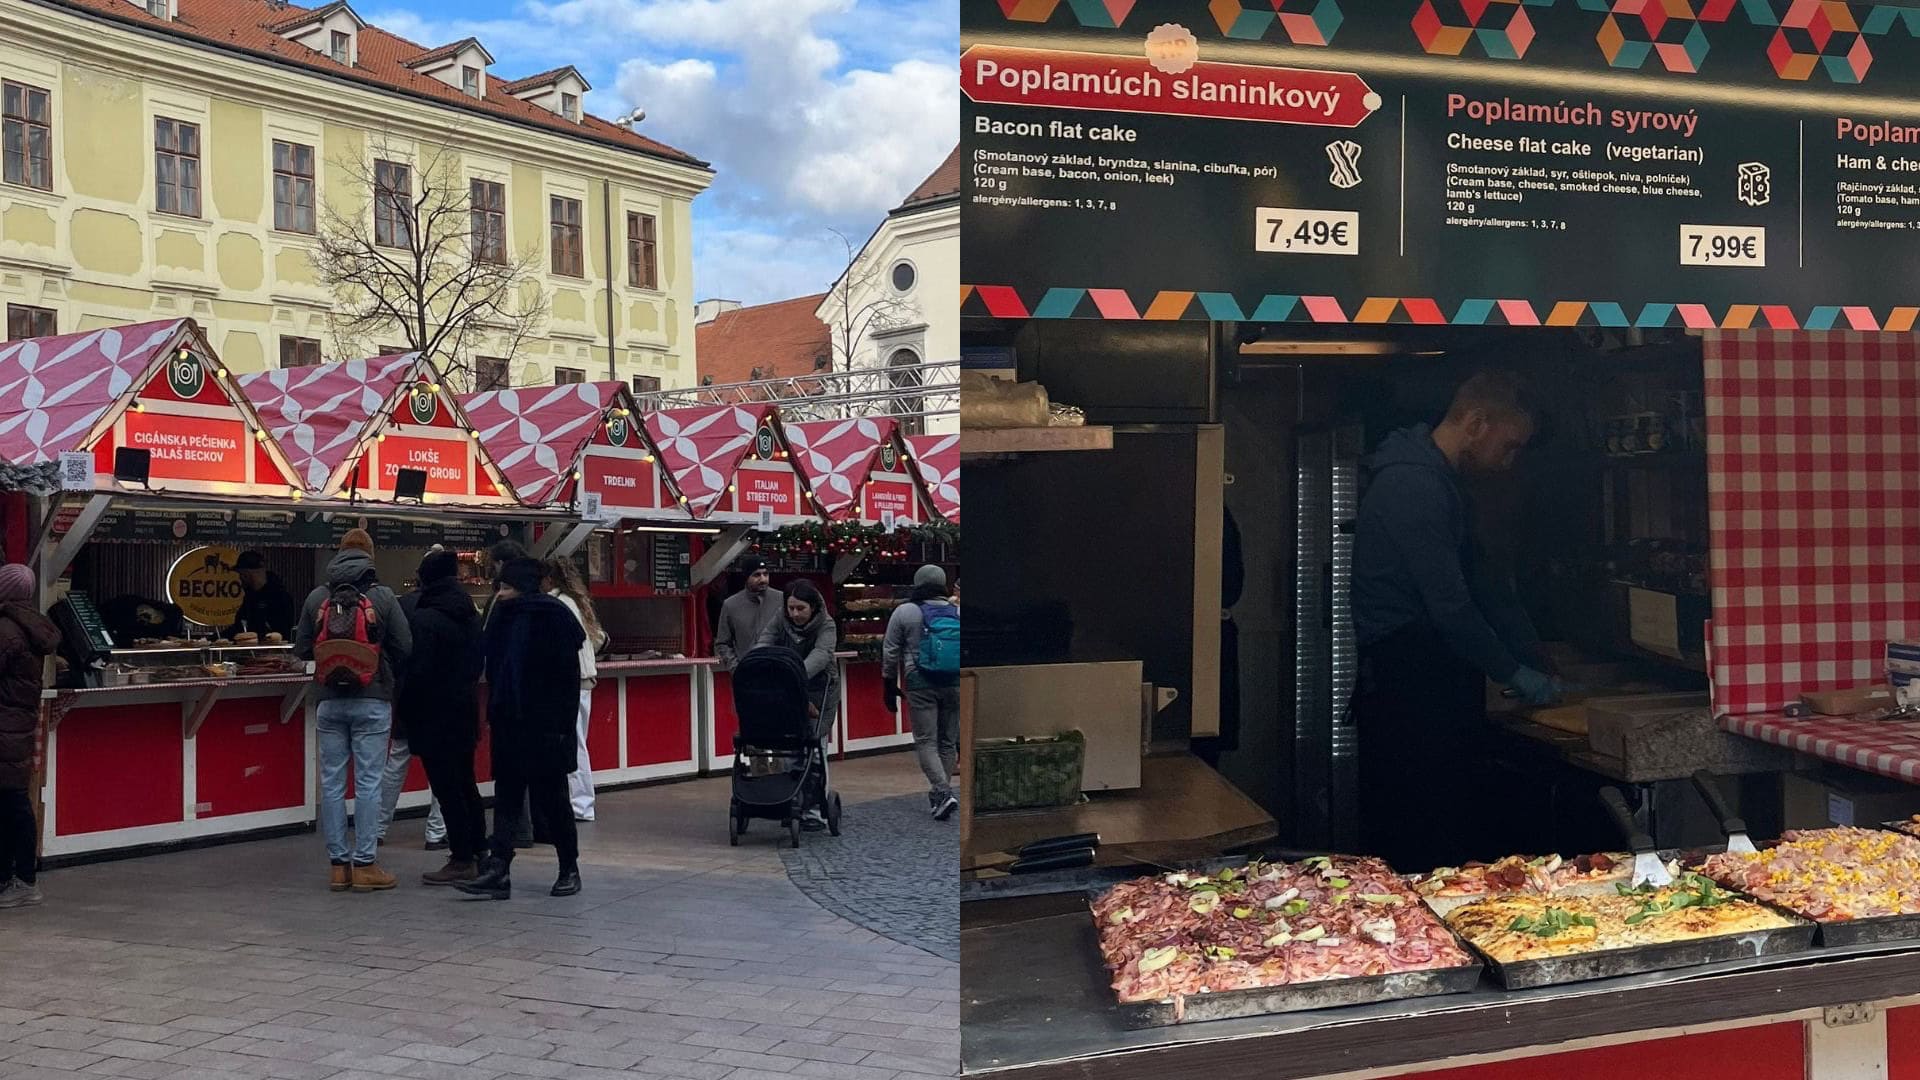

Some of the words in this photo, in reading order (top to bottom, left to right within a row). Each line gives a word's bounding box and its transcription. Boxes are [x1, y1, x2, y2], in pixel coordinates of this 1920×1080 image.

[976, 59, 1162, 97] Poplamúch
[1172, 75, 1341, 116] slaninkový
[1447, 93, 1602, 125] Poplamúch
[1611, 108, 1698, 137] syrový
[975, 116, 1043, 137] Bacon
[1049, 121, 1083, 139] flat
[1088, 125, 1137, 142] cake
[1837, 118, 1920, 146] Poplam
[1447, 132, 1514, 151] Cheese
[1519, 137, 1547, 153] flat
[1551, 139, 1591, 155] cake
[1606, 141, 1704, 165] (vegetarian)
[973, 149, 1049, 165] (Smotanový
[1051, 154, 1095, 167] základ,
[1098, 156, 1150, 169] bryndza,
[1154, 159, 1200, 173] slanina,
[1203, 162, 1250, 176] cibuľka,
[1253, 165, 1278, 178] pór)
[1837, 154, 1871, 169] Ham
[1876, 155, 1887, 170] &
[1892, 157, 1920, 171] che
[973, 163, 1019, 175] (Cream
[1022, 165, 1056, 178] base,
[1059, 168, 1101, 182] bacon,
[1103, 172, 1142, 183] onion,
[1145, 172, 1174, 185] leek)
[1446, 163, 1510, 177] (Smotanový
[1512, 166, 1548, 178] základ,
[1550, 170, 1569, 180] syr,
[1572, 169, 1617, 181] oštiepok,
[1620, 172, 1643, 183] niva,
[1646, 174, 1690, 186] polníček)
[973, 177, 995, 188] 120
[998, 180, 1007, 191] g
[1446, 176, 1485, 187] (Cream
[1487, 178, 1515, 189] base,
[1518, 180, 1558, 191] cheese,
[1560, 182, 1600, 192] smoked
[1602, 184, 1640, 195] cheese,
[1643, 185, 1664, 195] blue
[1666, 187, 1703, 198] cheese,
[1837, 181, 1885, 193] (Rajčinový
[1886, 184, 1916, 194] základ,
[972, 194, 1072, 208] alergény/allergens:
[1075, 199, 1083, 209] 1,
[1086, 200, 1095, 210] 3,
[1098, 200, 1107, 210] 7,
[1110, 202, 1116, 210] 8
[1446, 189, 1481, 199] lamb's
[1484, 190, 1523, 203] lettuce)
[1837, 193, 1873, 203] (Tomato
[1875, 195, 1899, 205] base,
[1901, 196, 1920, 204] ham
[1446, 201, 1465, 211] 120
[1467, 204, 1475, 213] g
[1837, 205, 1853, 214] 120
[1855, 207, 1861, 216] g
[1446, 217, 1528, 228] alergény/allergens:
[1531, 220, 1539, 228] 1,
[1541, 220, 1549, 229] 3,
[1267, 219, 1348, 248] 7,49€
[1689, 235, 1756, 262] 7,99€
[134, 431, 188, 446] CIGÁNSKA
[190, 434, 236, 449] PEČIENKA
[150, 447, 182, 460] SALAŠ
[184, 450, 223, 462] BECKOV
[409, 448, 439, 463] LOKŠE
[385, 464, 398, 475] ZO
[430, 467, 461, 480] GROBU
[746, 491, 769, 502] STREET
[771, 493, 788, 503] FOOD
[179, 579, 241, 598] BECKO
